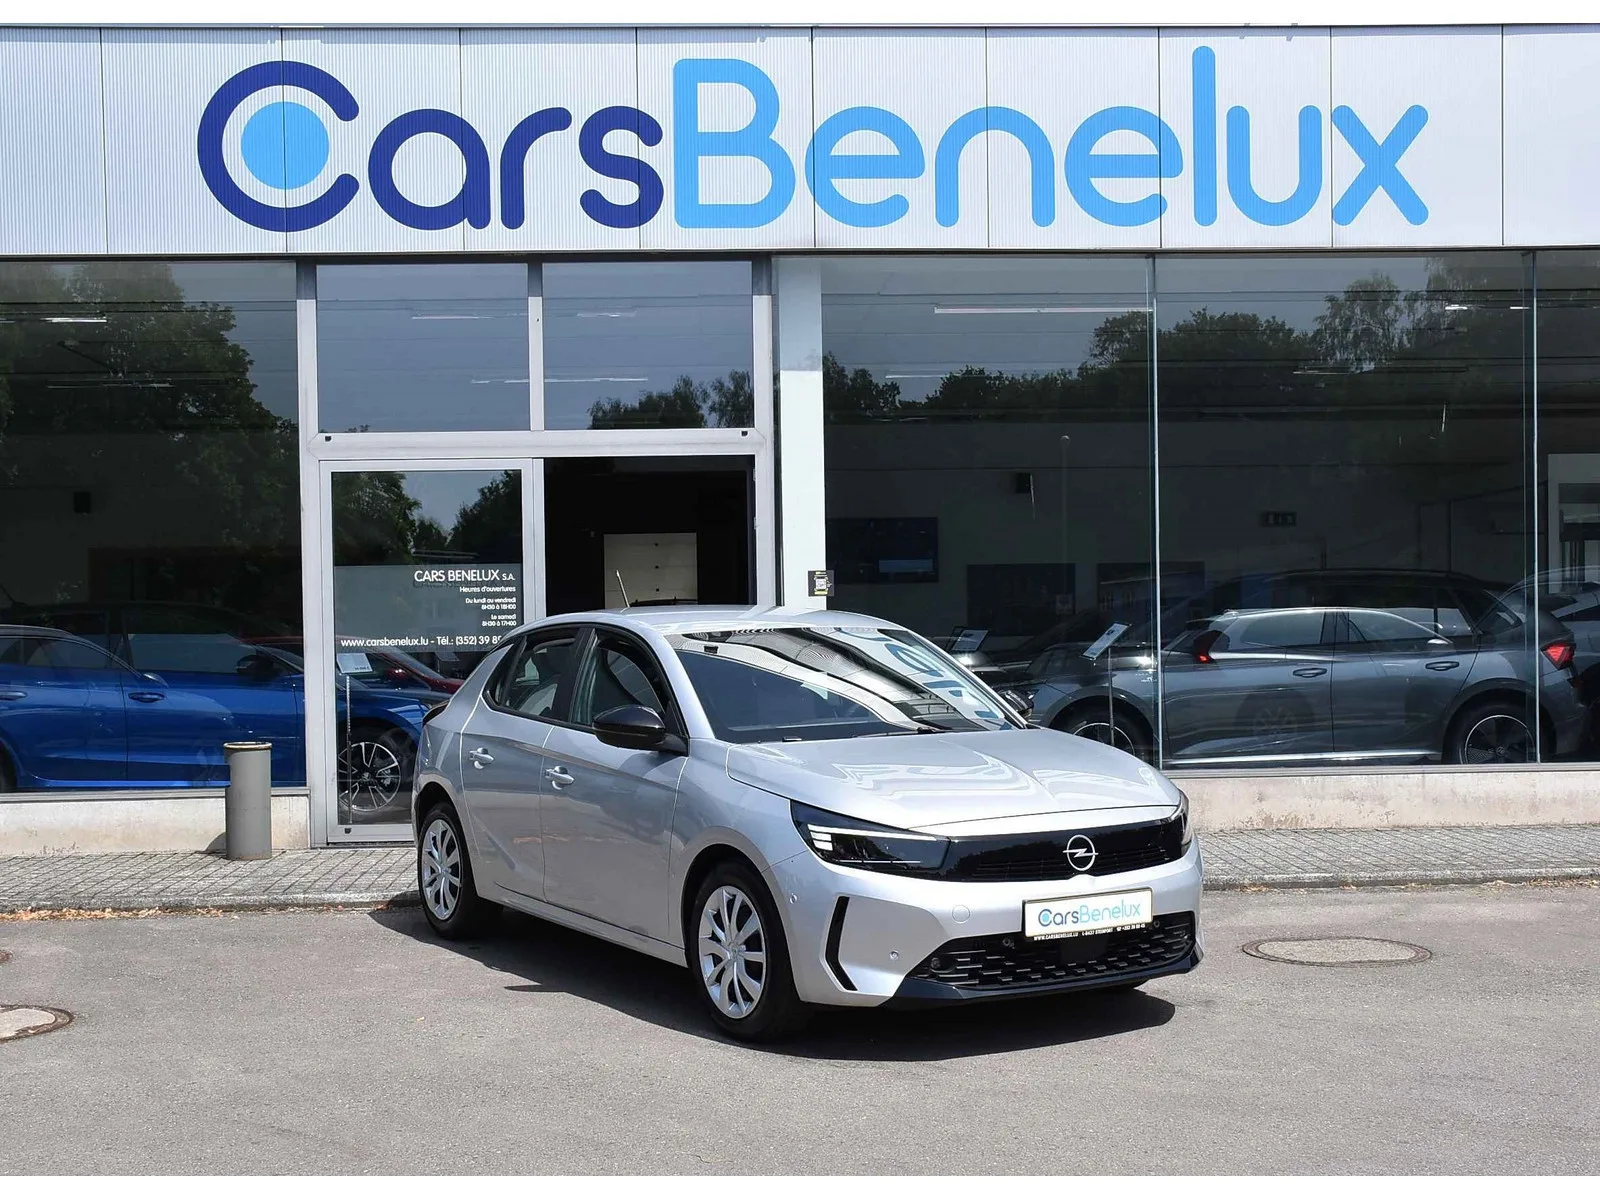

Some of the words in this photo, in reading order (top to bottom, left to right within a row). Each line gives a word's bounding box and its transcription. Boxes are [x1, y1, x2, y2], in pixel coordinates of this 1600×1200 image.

[197, 45, 1429, 233] CarsBenelux
[413, 570, 446, 582] CARS
[447, 569, 500, 581] BENELUX
[501, 573, 516, 581] S.A.
[340, 636, 429, 647] www.carsbenelux.lu
[455, 635, 477, 646] (352)
[478, 635, 489, 645] 39
[1038, 898, 1141, 927] CarsBenelux
